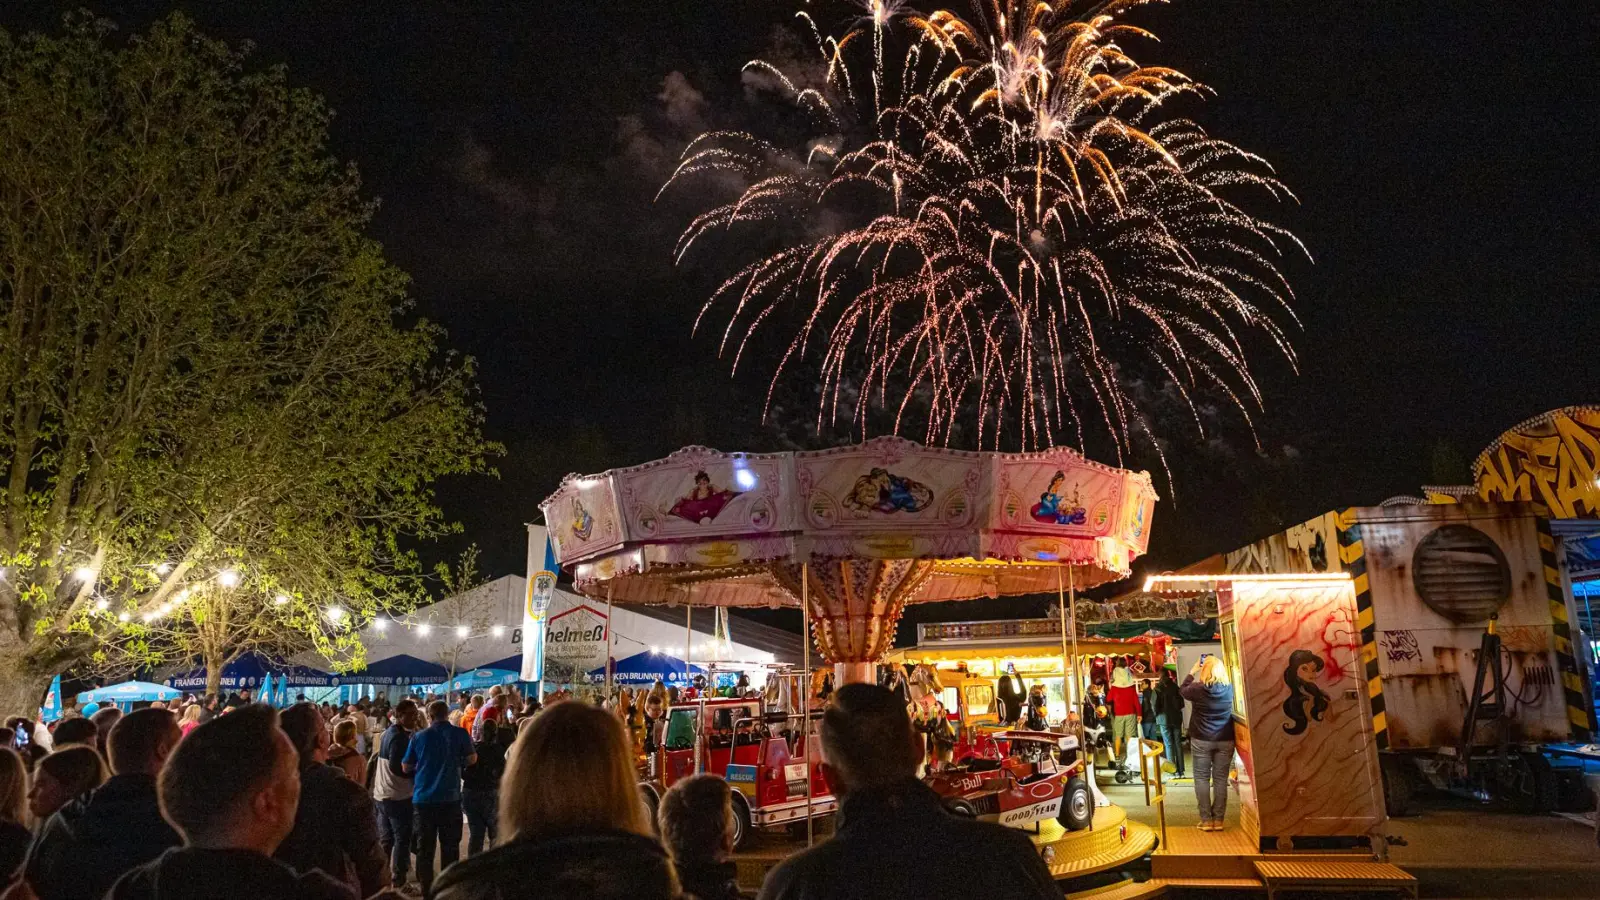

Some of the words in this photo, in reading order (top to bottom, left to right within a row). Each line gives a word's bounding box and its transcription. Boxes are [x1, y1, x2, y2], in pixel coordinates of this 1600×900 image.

[511, 625, 603, 644] Bhelmeß
[295, 676, 328, 685] BRUNNEN
[594, 672, 629, 681] FRKEN
[629, 672, 664, 681] BRUNNEN
[174, 677, 205, 687] FRANKEN
[730, 773, 754, 781] RESCUE
[961, 775, 983, 791] Bull
